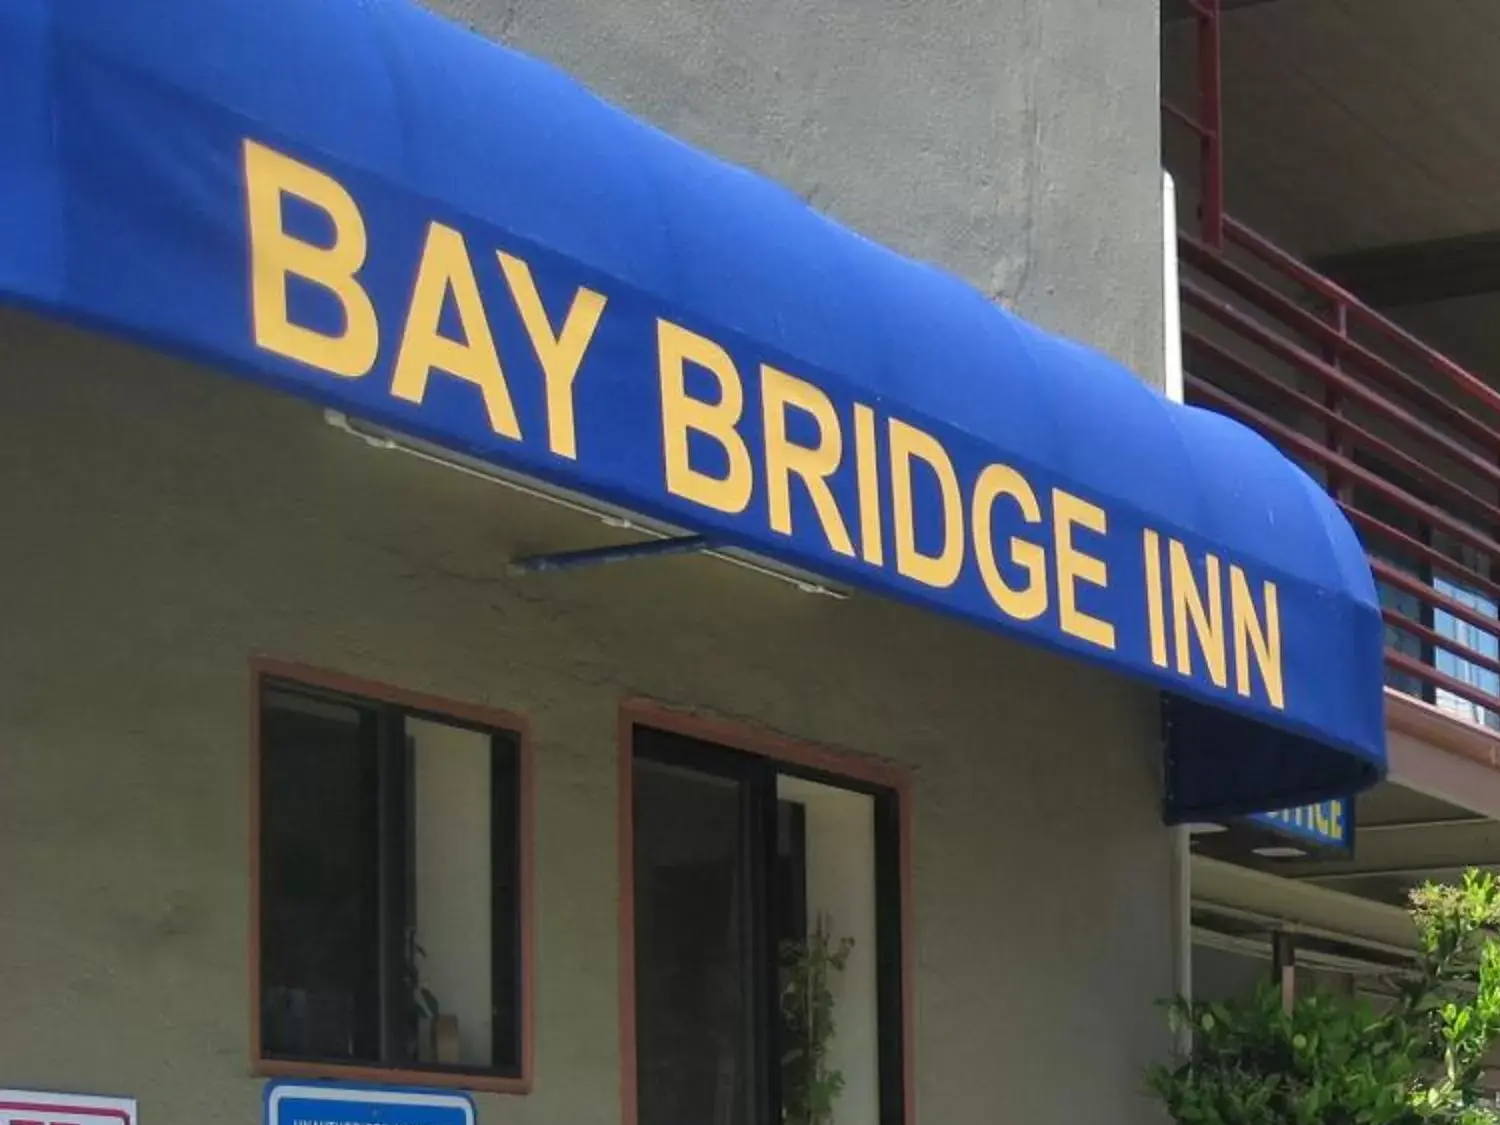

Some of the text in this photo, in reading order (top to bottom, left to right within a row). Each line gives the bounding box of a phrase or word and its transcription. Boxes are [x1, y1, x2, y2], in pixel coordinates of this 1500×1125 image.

[244, 137, 1286, 709] BAY BRIDGE INN
